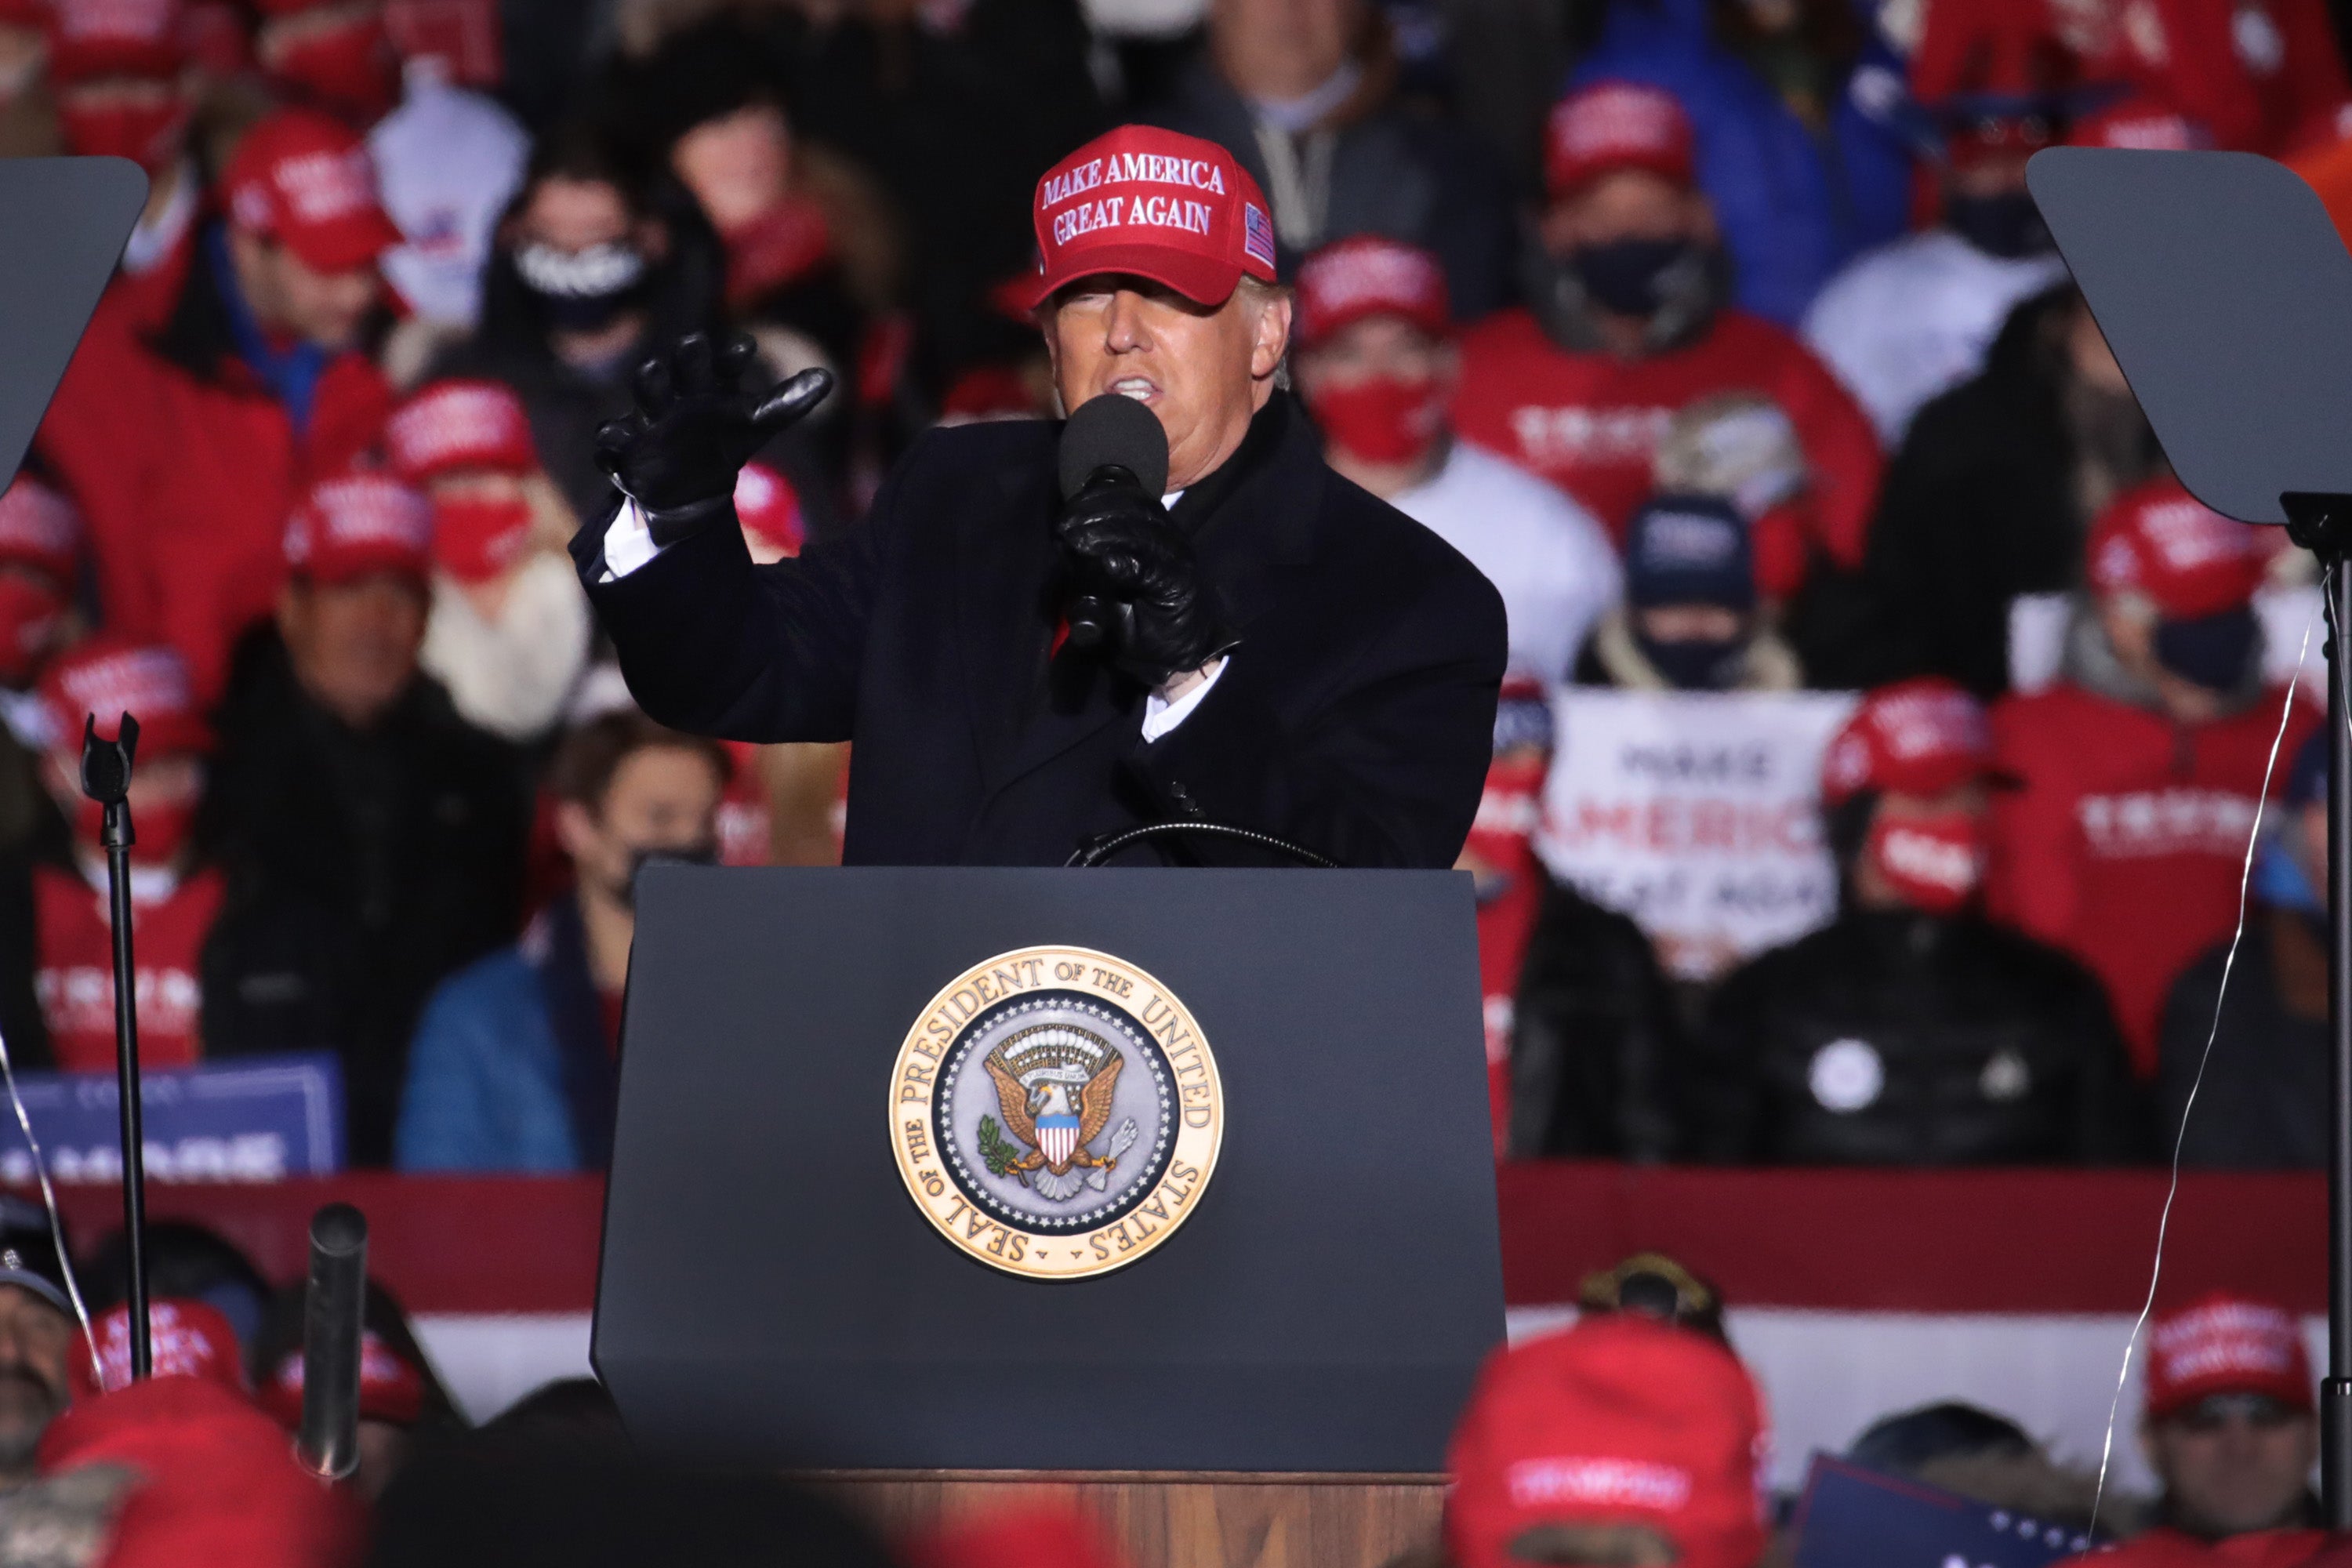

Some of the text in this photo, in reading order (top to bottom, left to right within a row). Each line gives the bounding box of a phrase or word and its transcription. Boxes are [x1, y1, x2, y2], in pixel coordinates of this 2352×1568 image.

[1042, 153, 1225, 209] MAKE AMERICA
[1053, 195, 1212, 246] GREAT AGAIN
[1541, 797, 1825, 860] MERIC
[901, 958, 1211, 1261] SEAL OF THE PRESIDENT OF THE UNITED STATES
